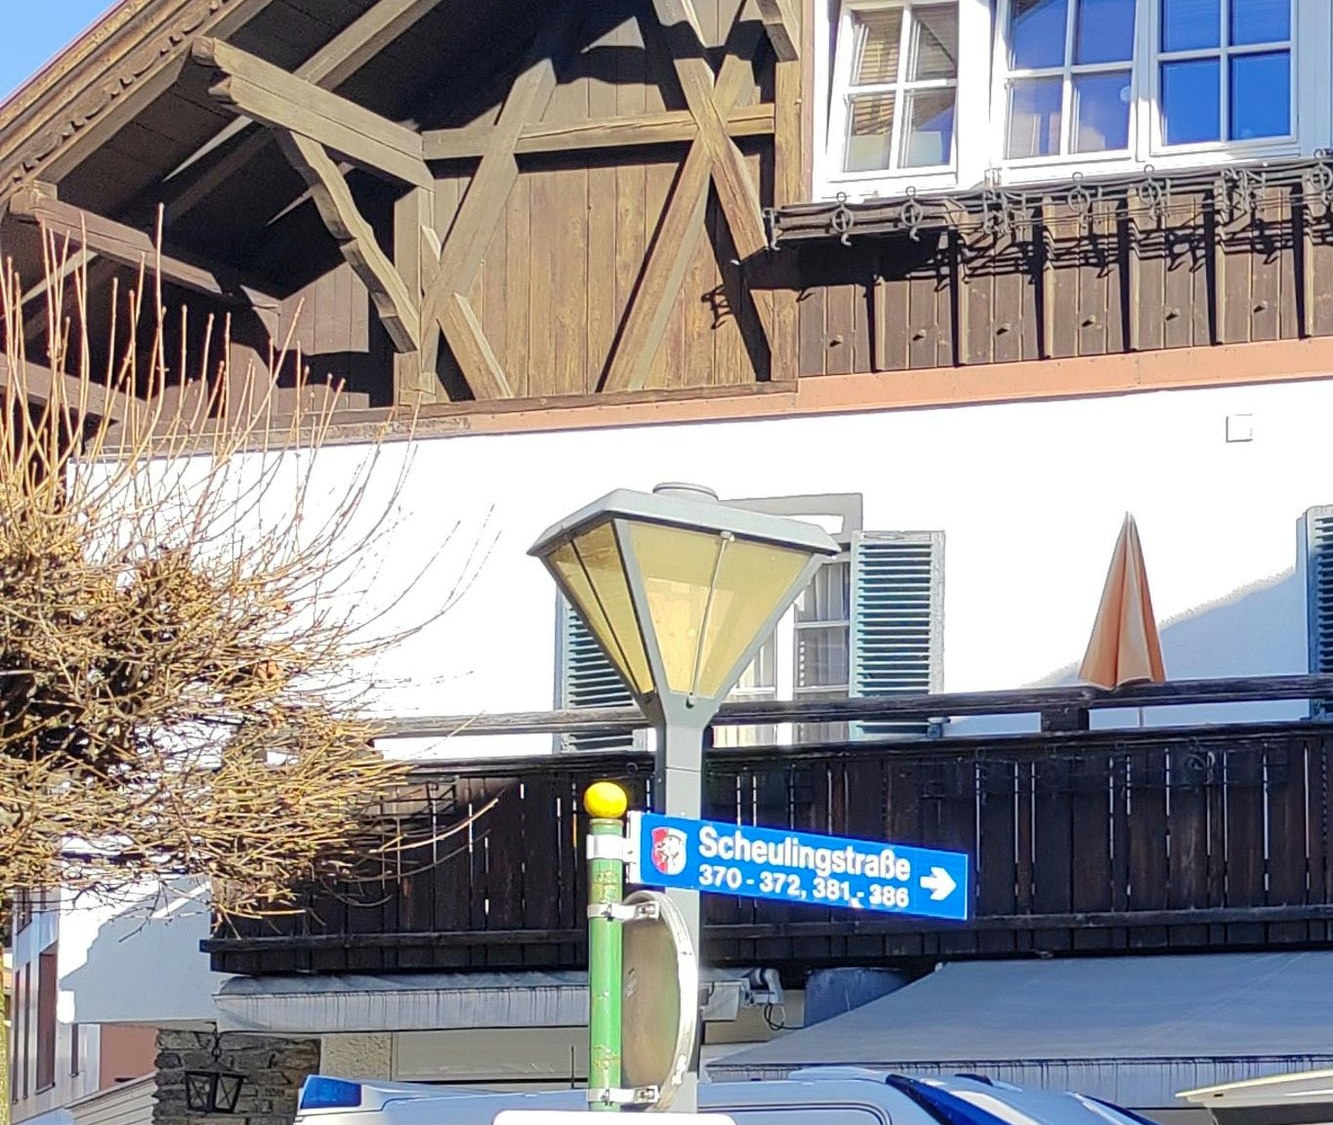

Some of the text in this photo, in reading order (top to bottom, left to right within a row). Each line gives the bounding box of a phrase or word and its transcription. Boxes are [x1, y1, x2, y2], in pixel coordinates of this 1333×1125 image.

[699, 826, 911, 882] Scheulingstraße
[699, 864, 742, 889] 370
[869, 884, 909, 909] 386
